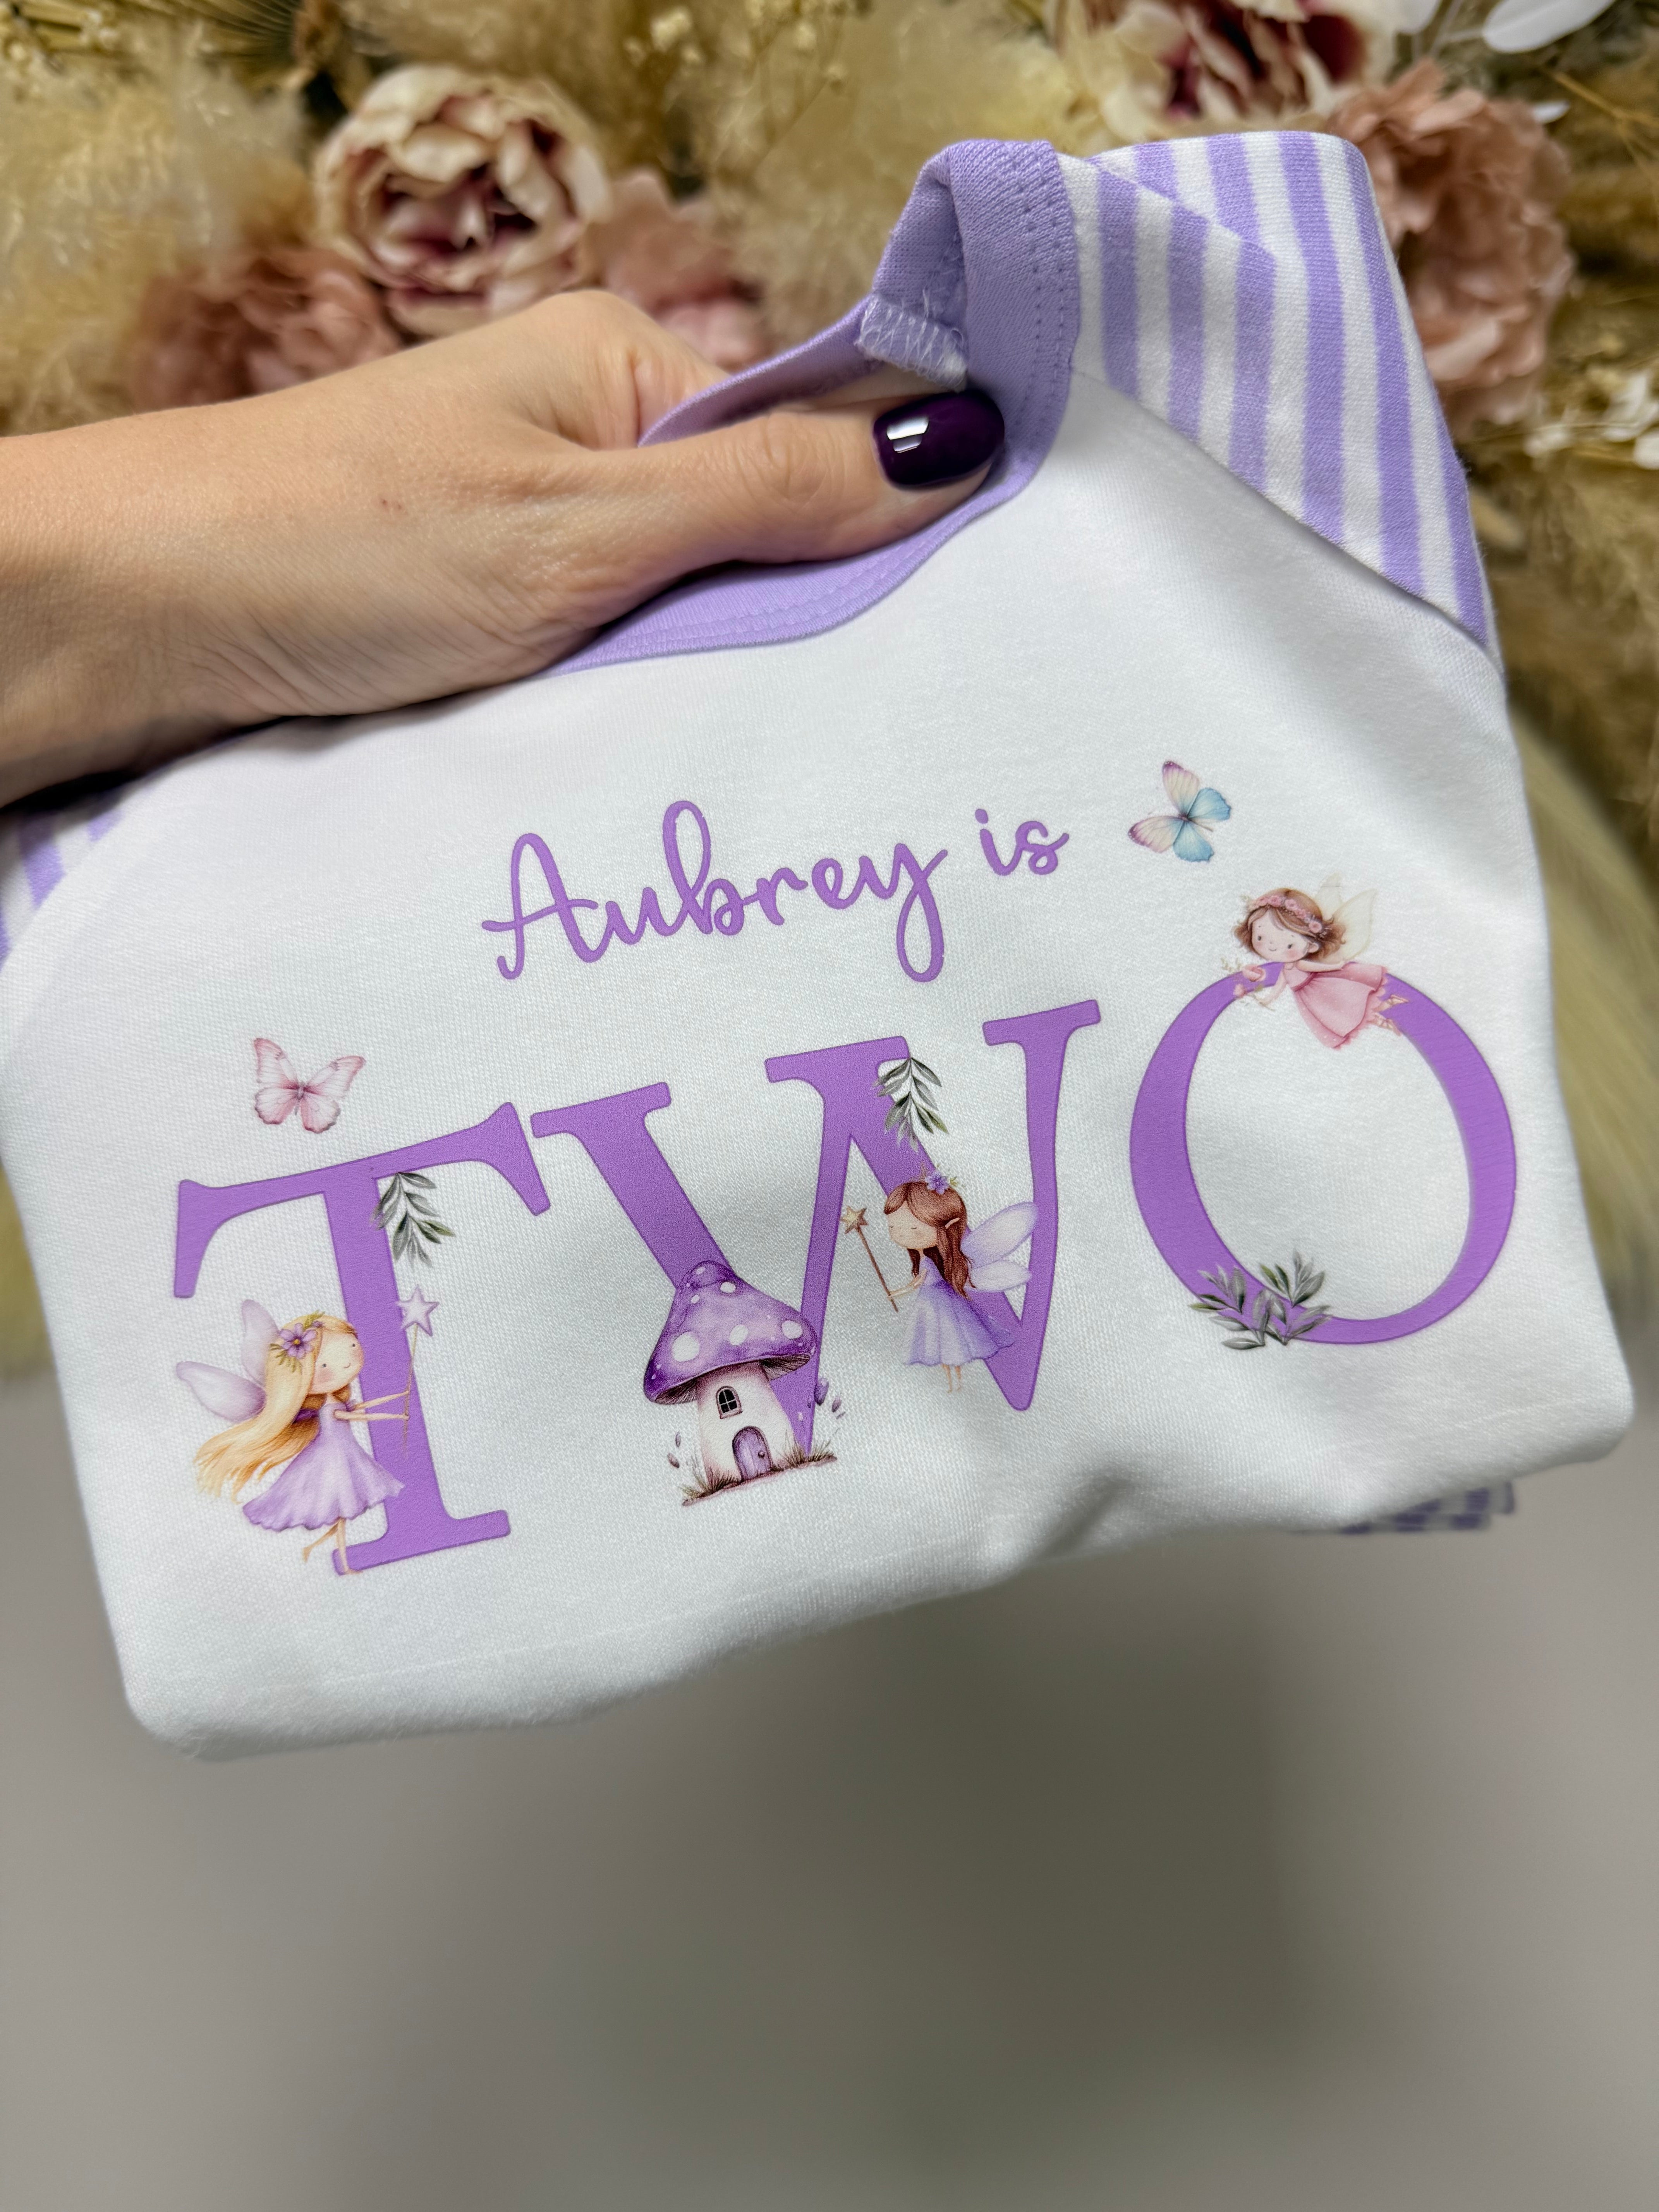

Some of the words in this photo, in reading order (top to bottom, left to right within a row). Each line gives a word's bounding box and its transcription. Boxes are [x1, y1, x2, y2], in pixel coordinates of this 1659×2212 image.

[483, 801, 946, 982] Aubrey
[975, 809, 1069, 876] is
[174, 962, 1516, 1575] TWO
